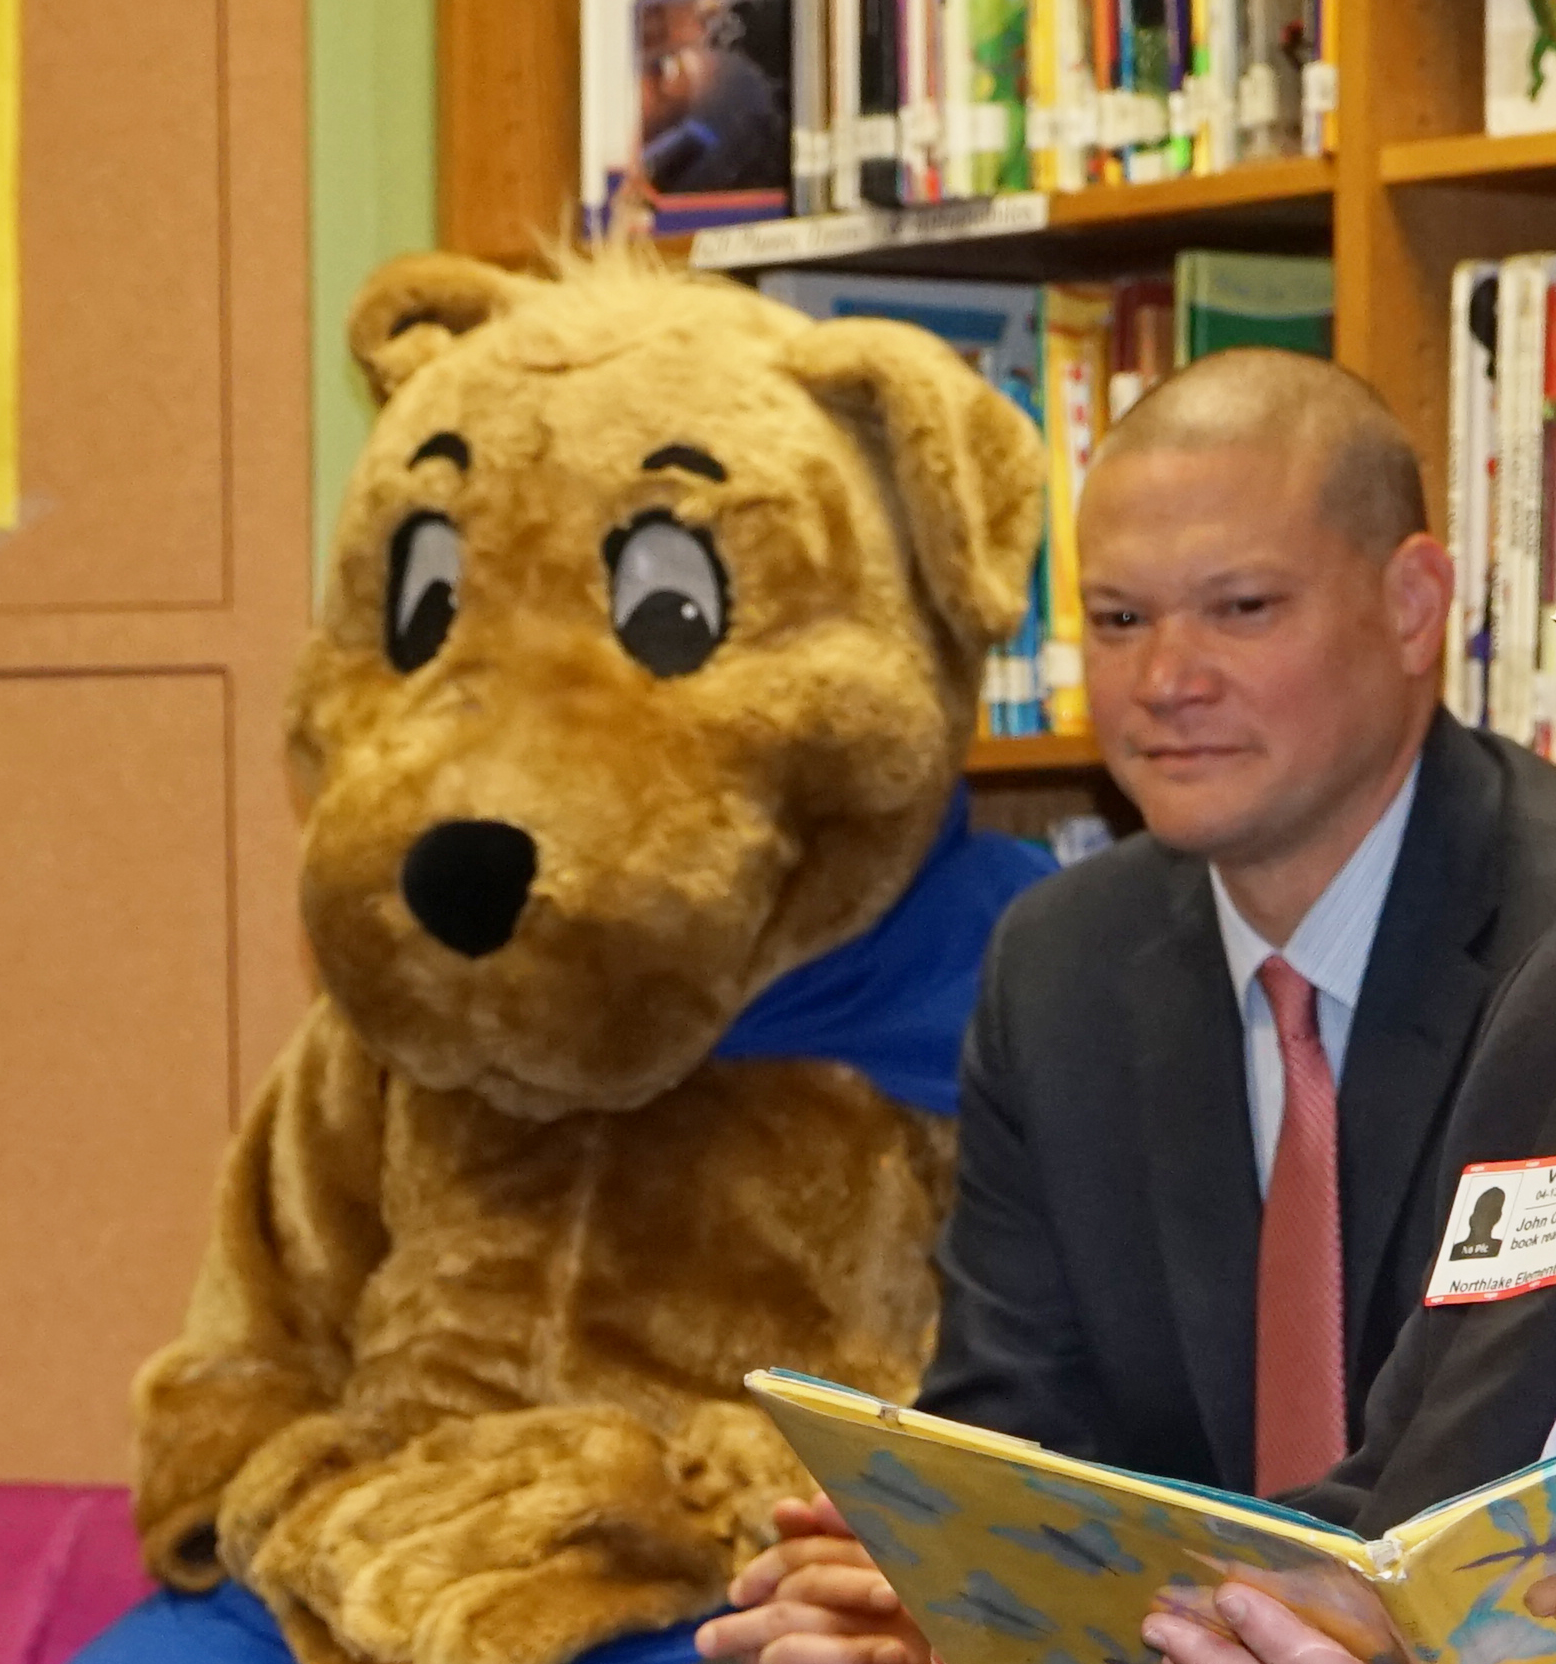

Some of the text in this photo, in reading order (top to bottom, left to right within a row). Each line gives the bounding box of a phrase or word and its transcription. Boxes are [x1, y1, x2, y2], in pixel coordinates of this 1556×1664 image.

[1516, 1217, 1547, 1232] John
[1461, 1243, 1490, 1255] No Pic
[1510, 1234, 1538, 1250] book
[1449, 1276, 1513, 1293] Northlake
